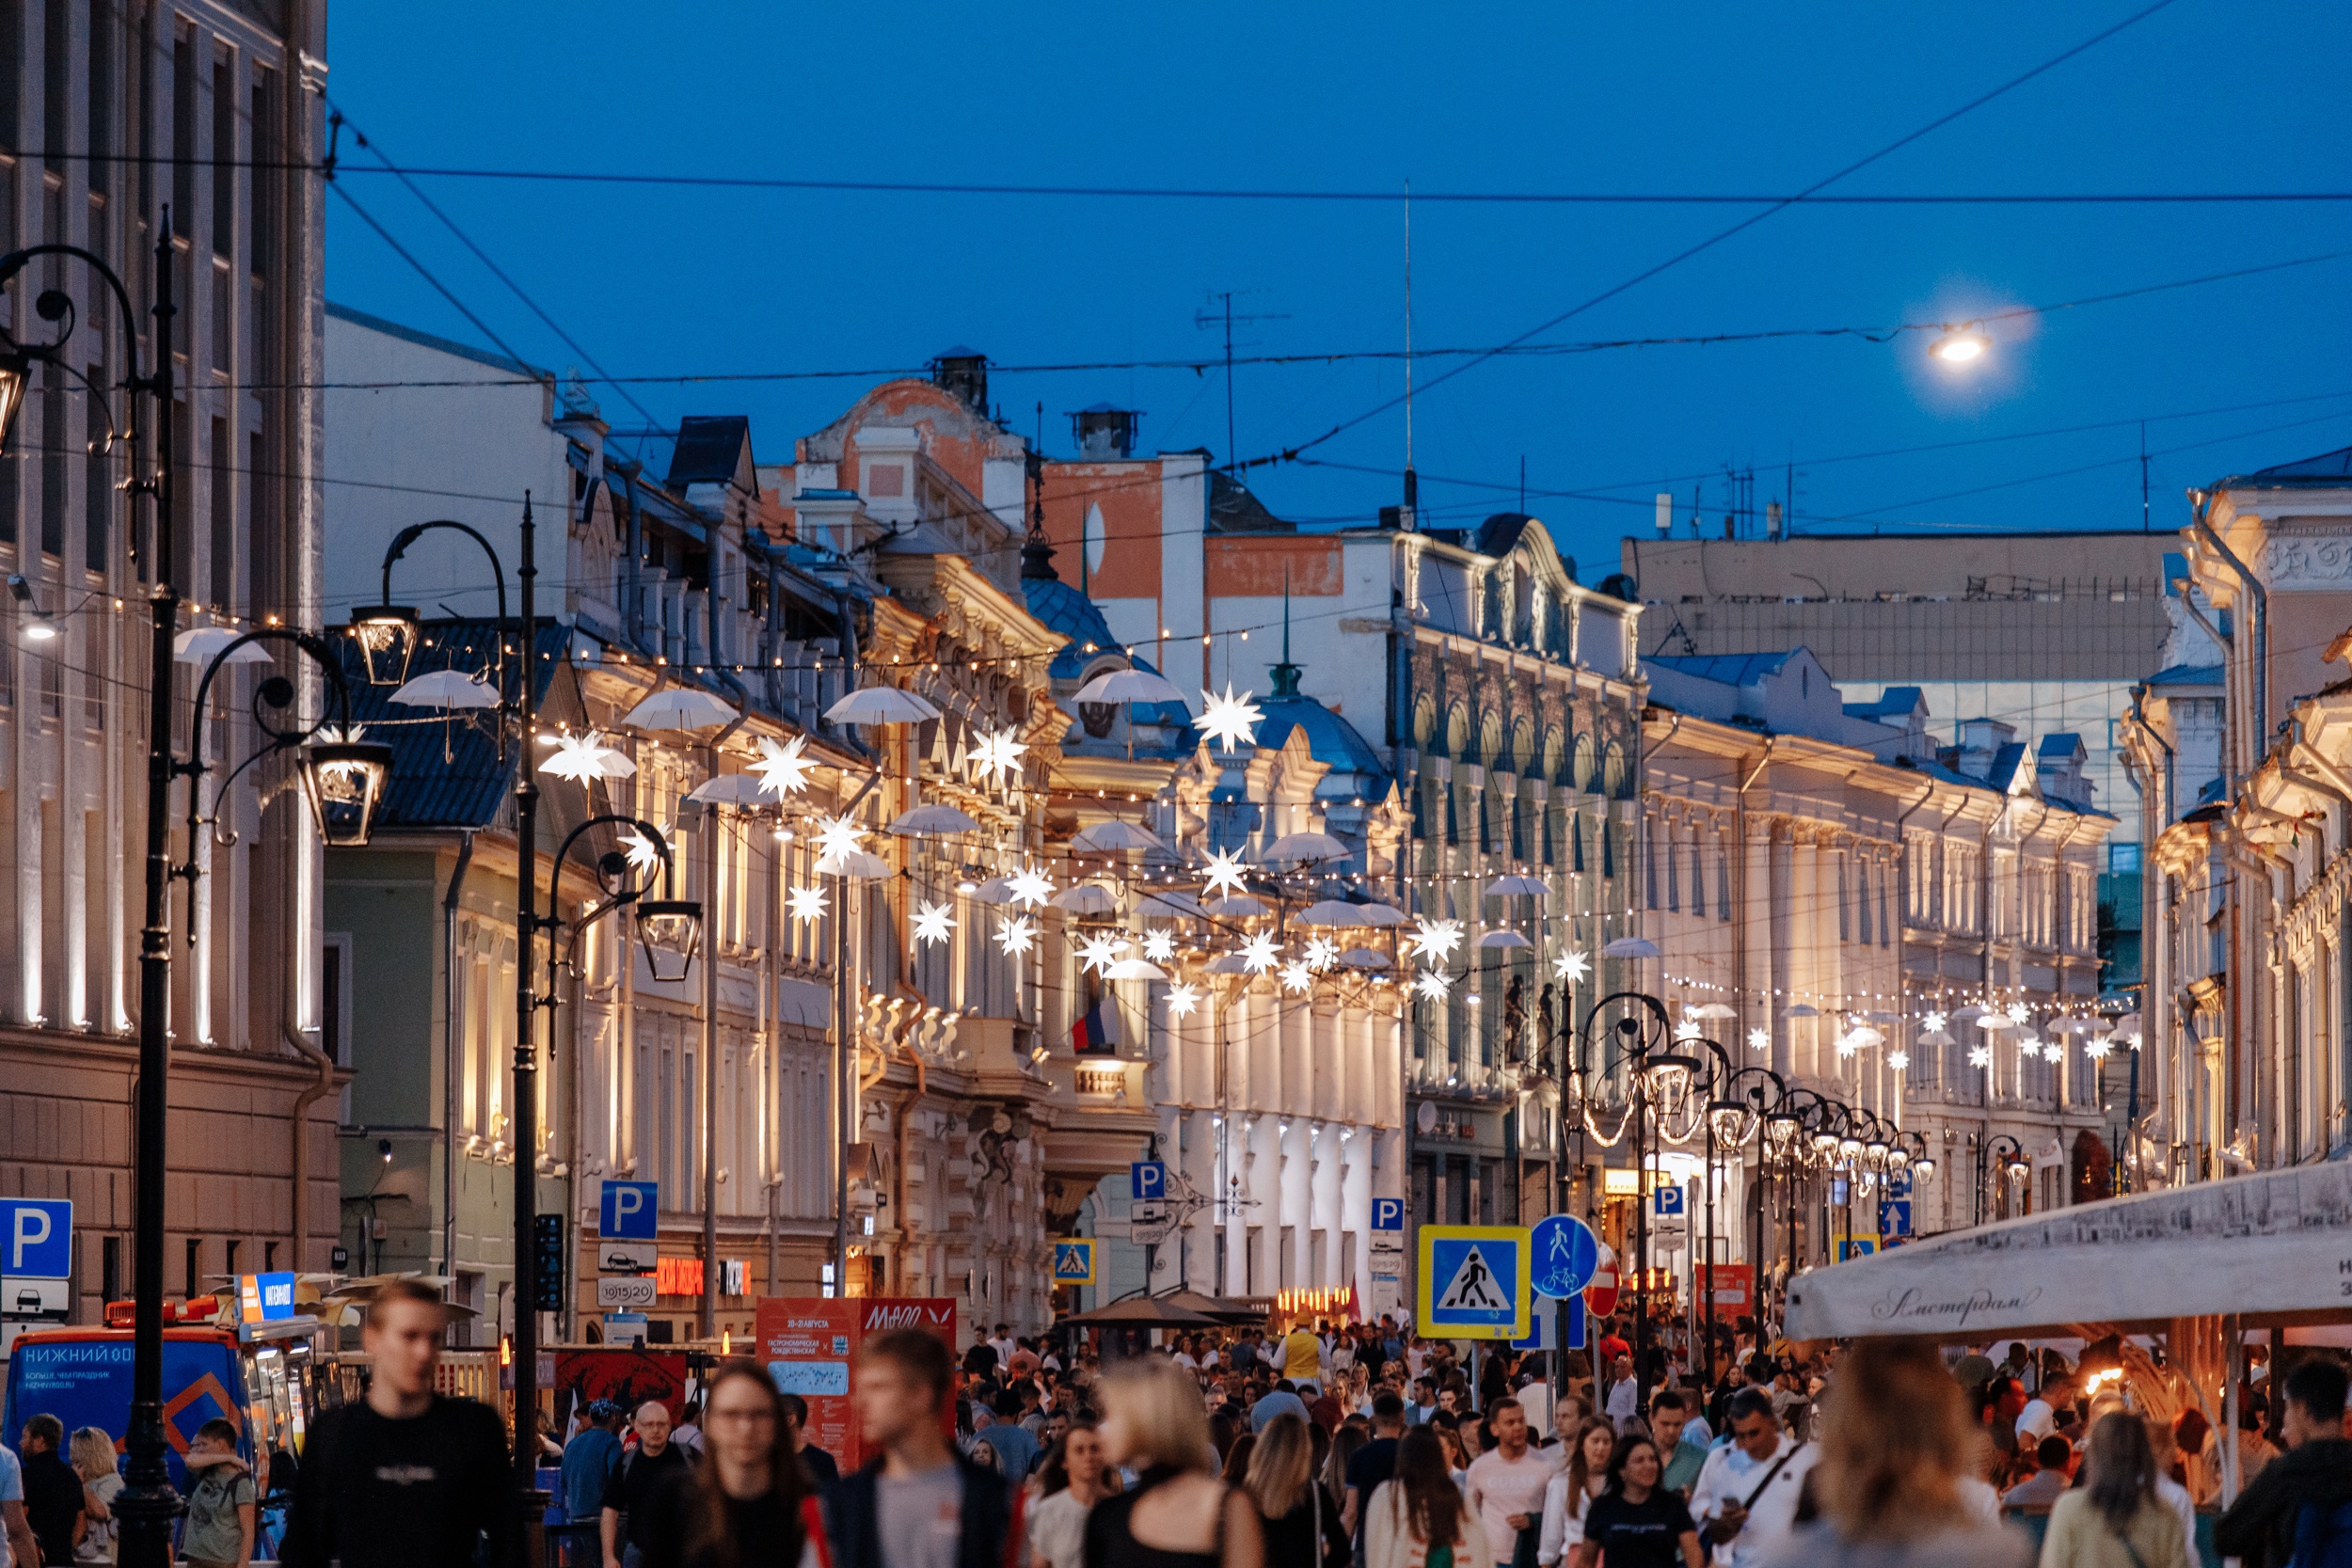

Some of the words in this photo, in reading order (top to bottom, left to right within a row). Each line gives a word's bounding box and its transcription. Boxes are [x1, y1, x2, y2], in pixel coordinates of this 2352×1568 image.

[1140, 1165, 1159, 1196] P
[614, 1186, 644, 1232] P
[1661, 1188, 1678, 1212] P
[1378, 1200, 1398, 1227] P
[12, 1207, 52, 1268] P
[604, 1288, 617, 1297] 10
[617, 1287, 628, 1297] 15
[632, 1287, 649, 1297] 20
[1871, 1286, 2042, 1326] Амстердам
[25, 1345, 107, 1362] НИЖНИЙ
[111, 1348, 135, 1362] 80
[768, 1338, 819, 1348] ГАСТРОНОМИЧЕСКАЯ
[771, 1347, 816, 1355] РОЖДЕСТВЕНСКАЯ
[73, 1370, 110, 1380] ПРАЗДНИК
